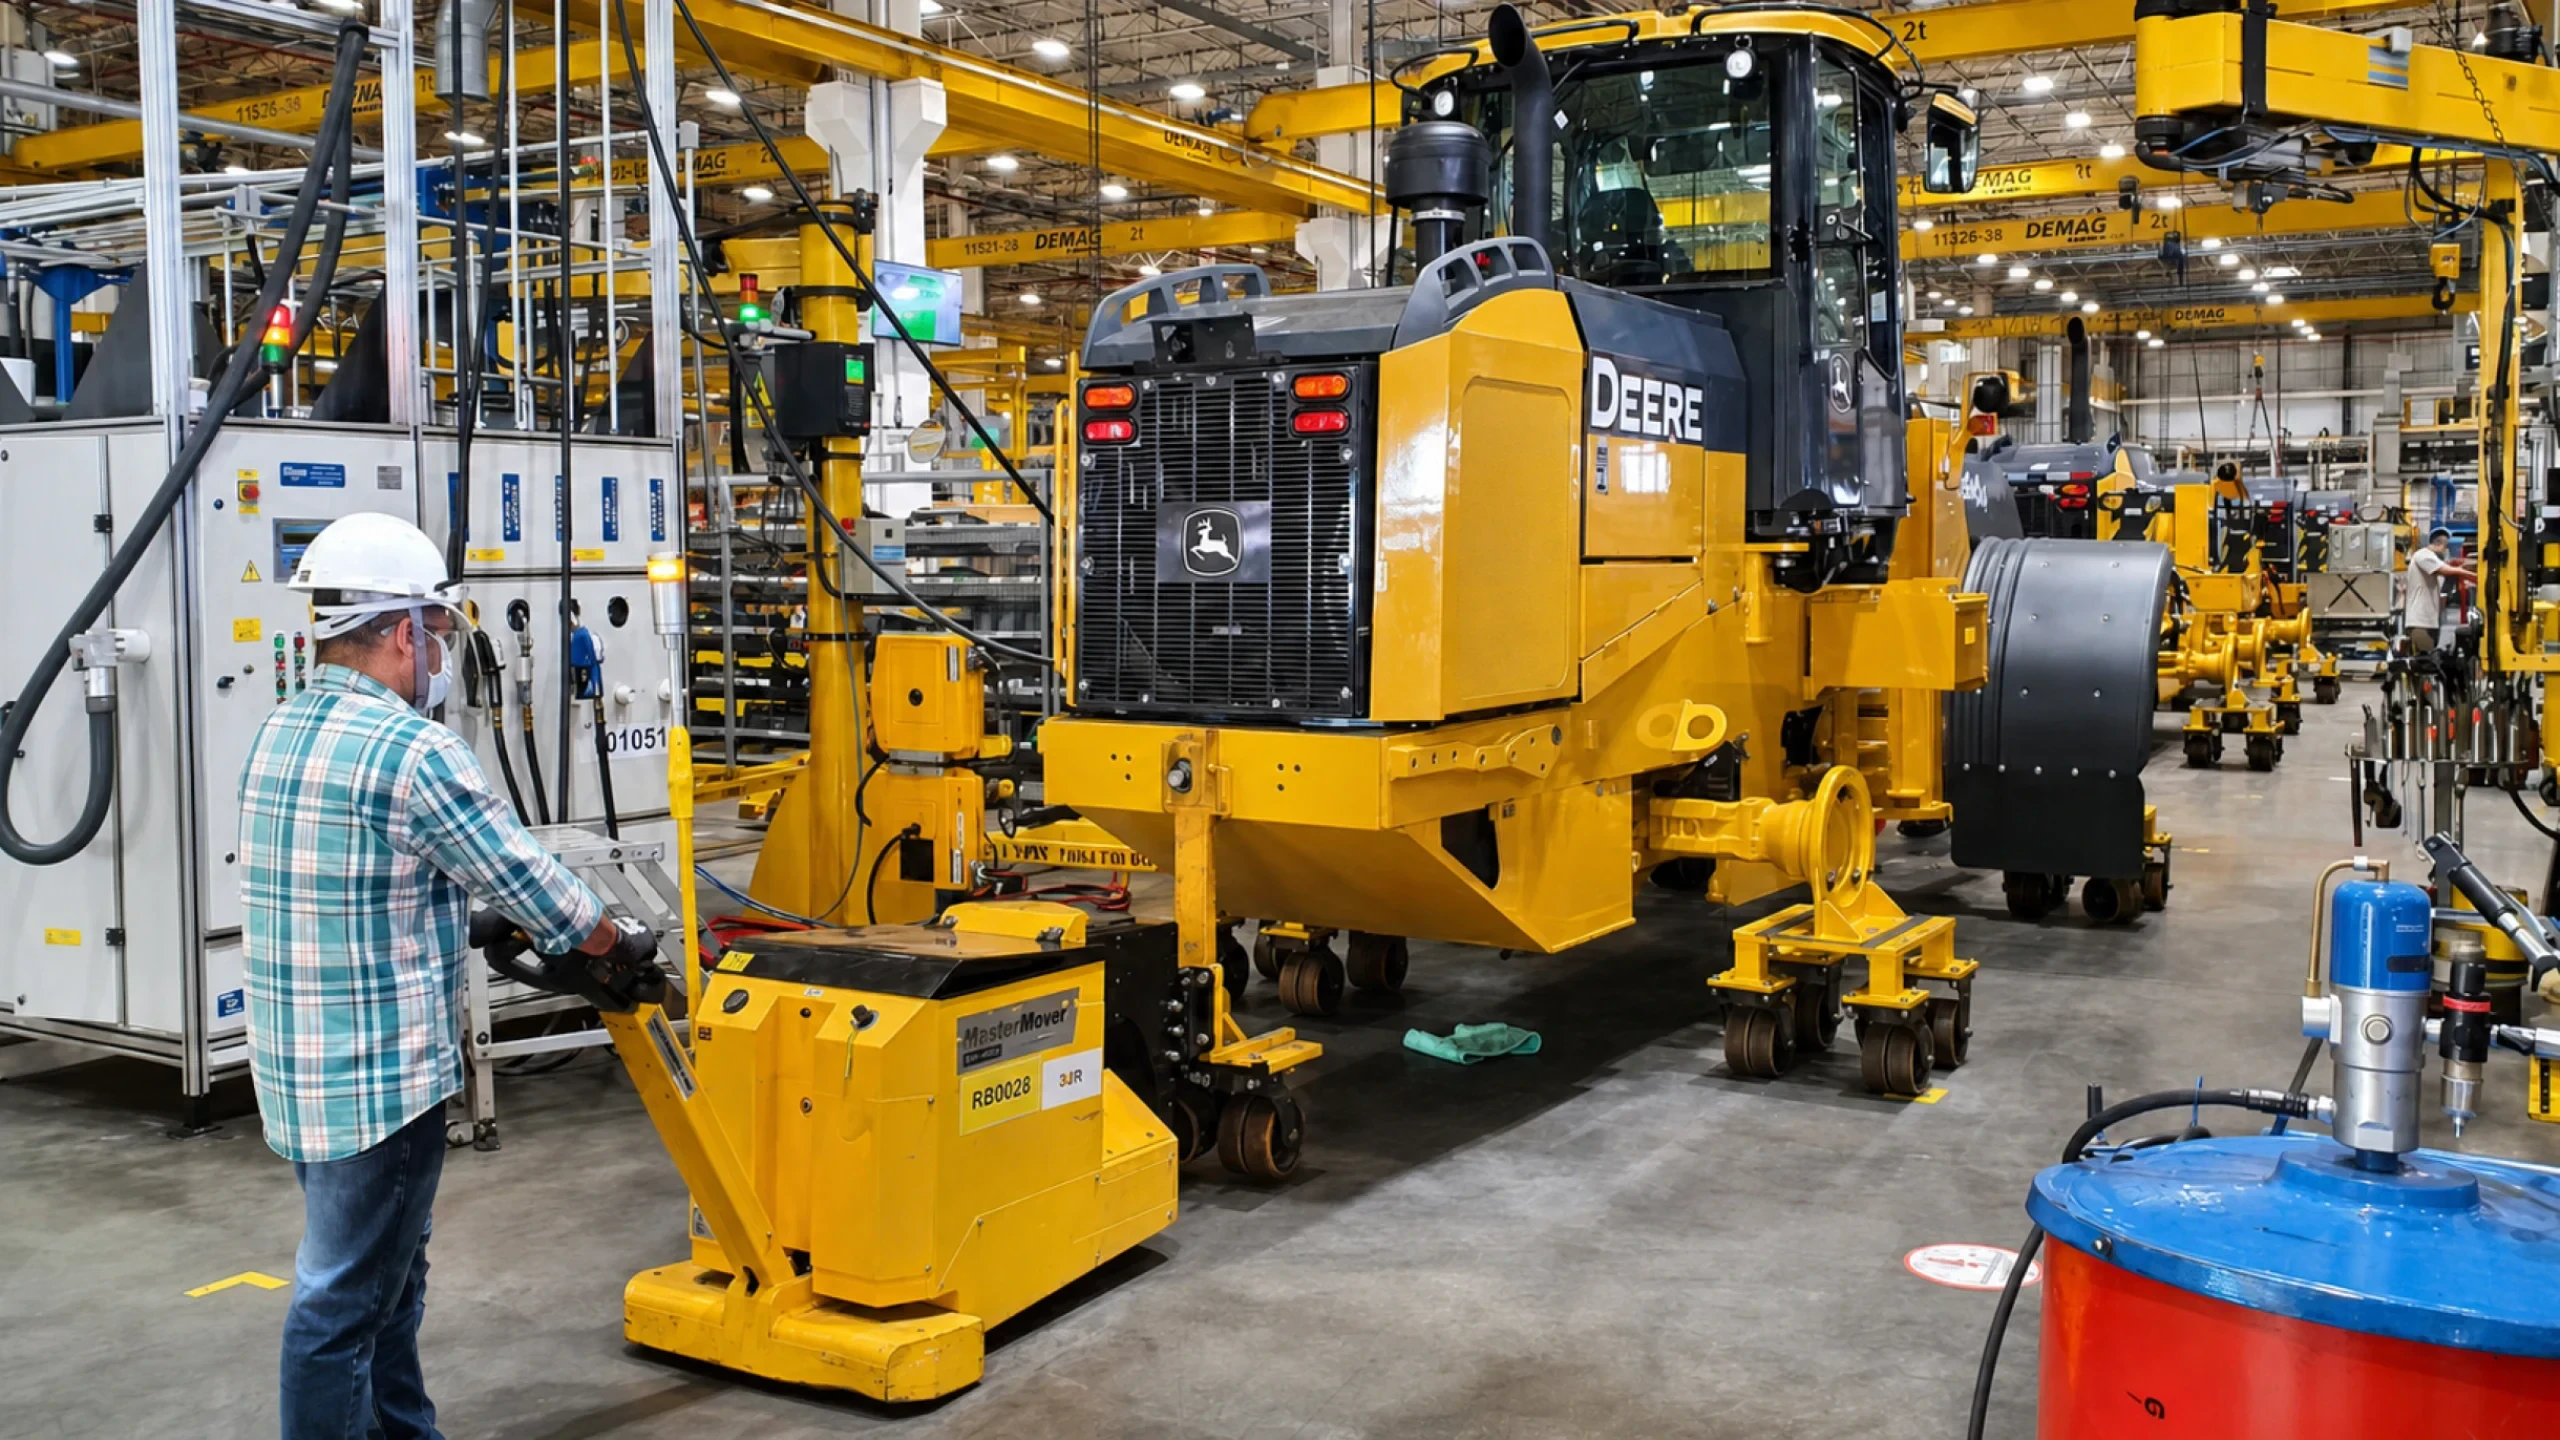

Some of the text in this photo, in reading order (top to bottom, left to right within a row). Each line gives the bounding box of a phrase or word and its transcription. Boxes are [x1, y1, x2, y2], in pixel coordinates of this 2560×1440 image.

[1903, 20, 1927, 41] 2t
[1034, 230, 1101, 250] DEMAG
[1130, 227, 1143, 241] 2t
[2026, 217, 2107, 239] DEMAG
[2175, 308, 2225, 321] DEMAG
[1591, 356, 1703, 441] DEERE
[962, 1008, 1067, 1049] MasterMover
[971, 1076, 1031, 1110] RB0028
